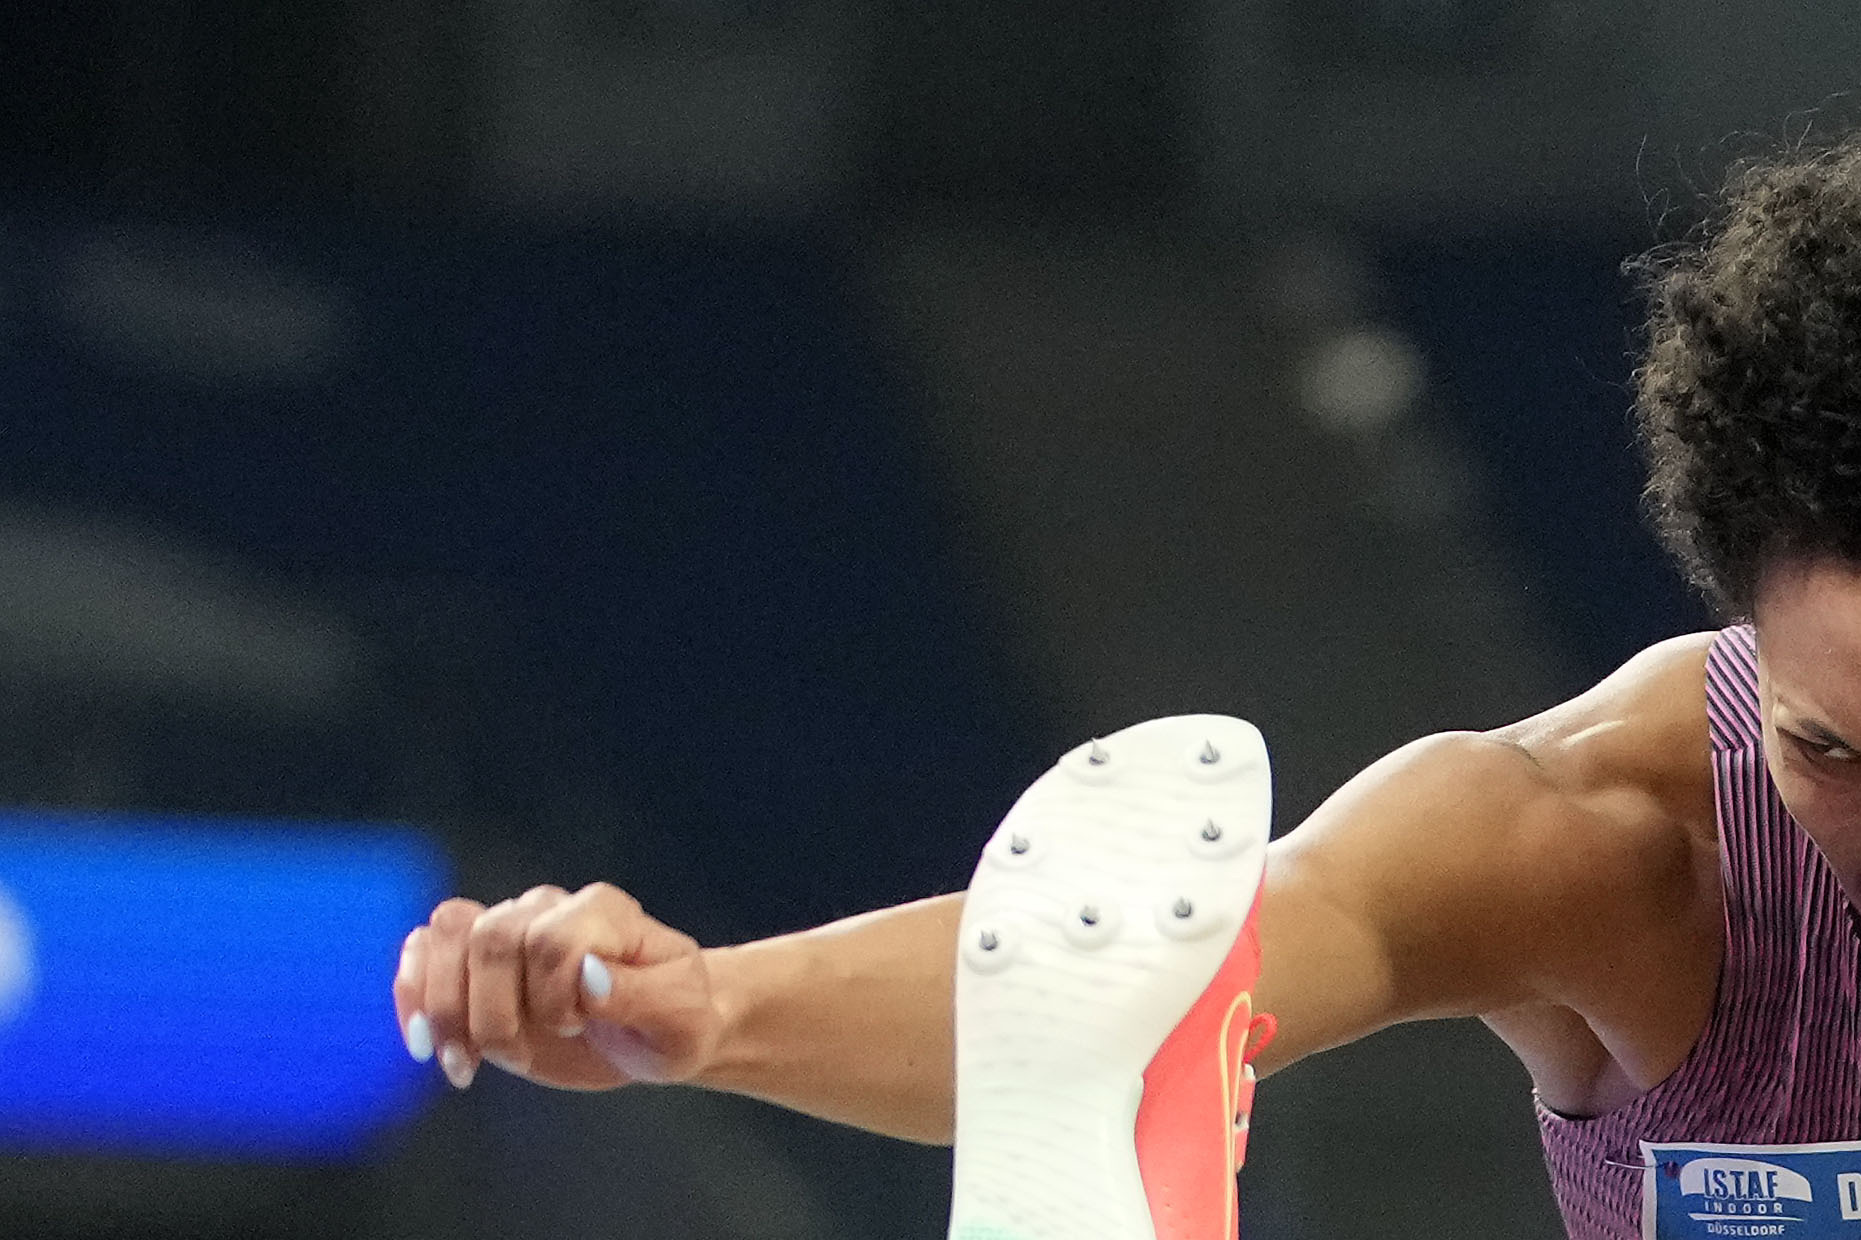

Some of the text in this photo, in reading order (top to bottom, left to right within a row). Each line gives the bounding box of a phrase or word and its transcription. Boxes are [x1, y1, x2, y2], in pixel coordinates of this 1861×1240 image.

[1704, 1168, 1778, 1200] ISTAF
[1704, 1201, 1783, 1214] INDOOR
[1707, 1222, 1785, 1236] DÜSSELDORF
